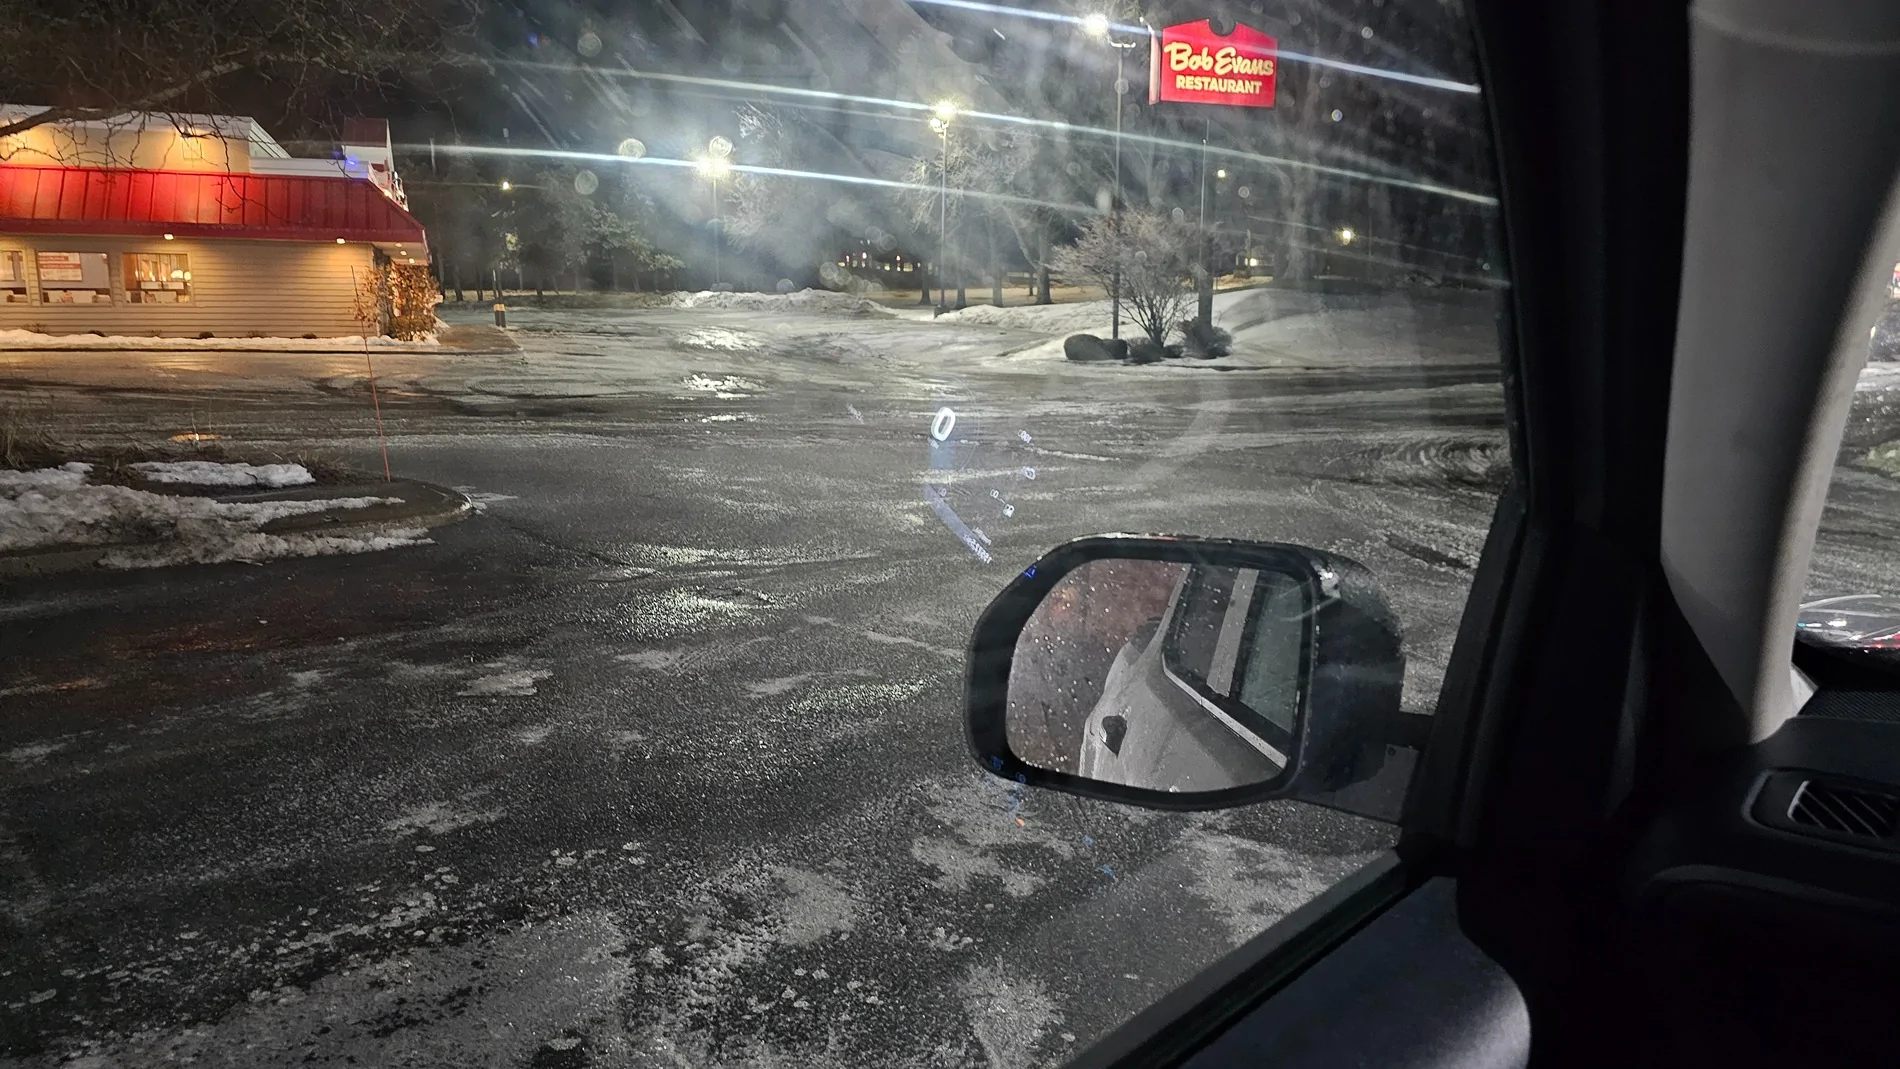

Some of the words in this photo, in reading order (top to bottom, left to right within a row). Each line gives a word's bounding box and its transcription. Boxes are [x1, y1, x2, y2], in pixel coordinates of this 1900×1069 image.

[1163, 41, 1214, 71] Bob
[1214, 47, 1274, 76] Evans
[1175, 74, 1262, 95] RESTAURANT
